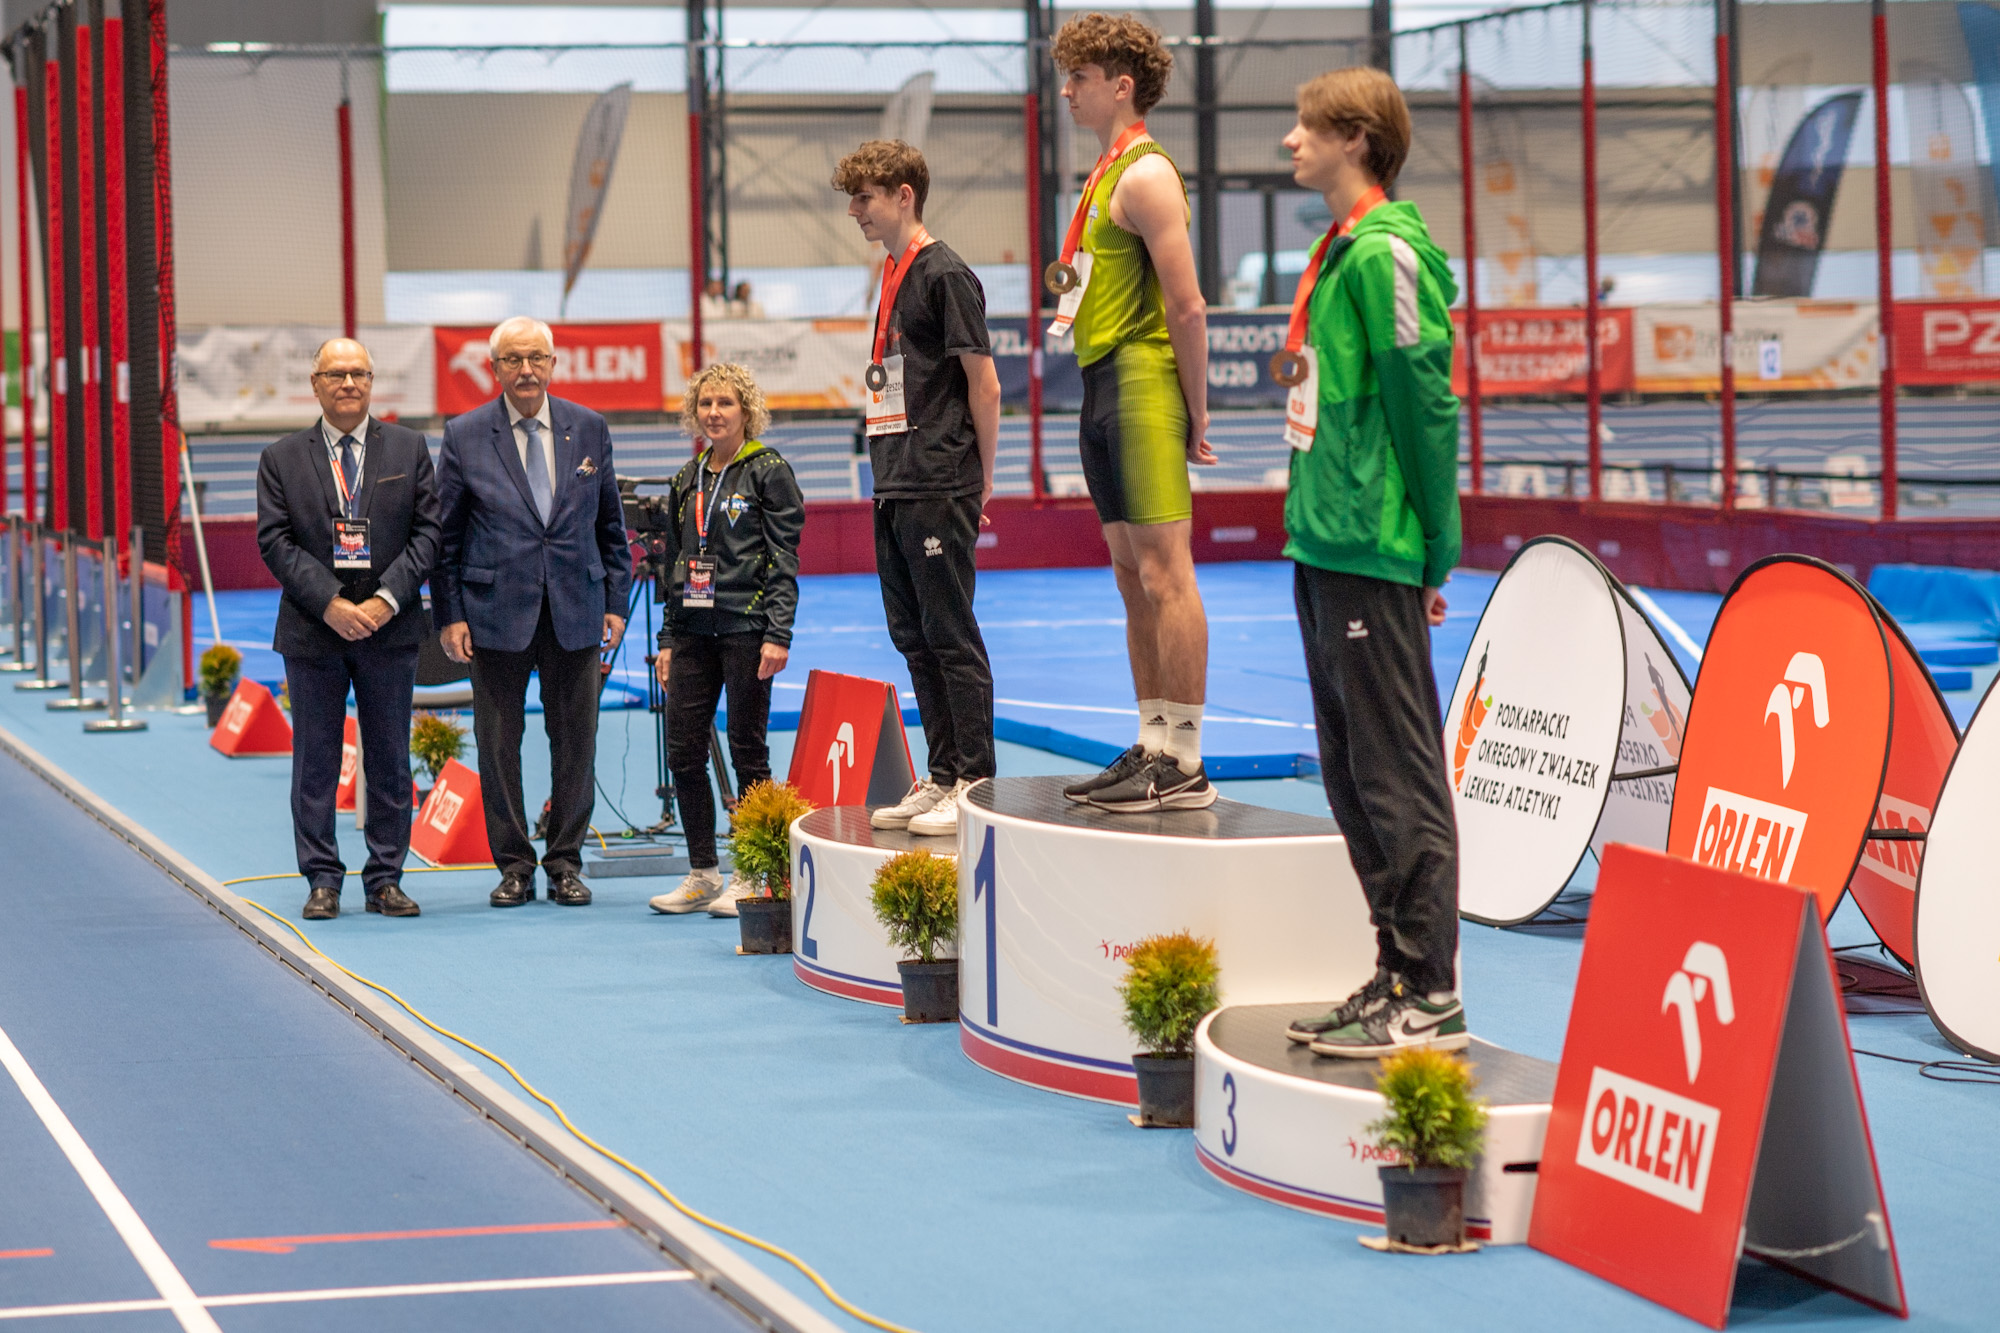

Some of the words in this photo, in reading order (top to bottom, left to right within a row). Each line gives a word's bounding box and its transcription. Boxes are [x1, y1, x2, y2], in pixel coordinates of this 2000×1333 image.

[552, 345, 646, 382] RLEN
[1207, 361, 1258, 387] U20
[1495, 703, 1570, 739] PODKARPACKI
[1478, 738, 1538, 773] OKRĘGOWY
[1537, 751, 1599, 789] ZWIĄZEK
[1464, 775, 1505, 806] LEKKIEJ
[1503, 785, 1561, 820] ATLETYKI
[1699, 803, 1795, 881] ORLEN
[800, 844, 817, 960] 2
[974, 825, 998, 1028] 1
[1222, 1072, 1237, 1157] 3
[1590, 1087, 1707, 1192] ORLEN
